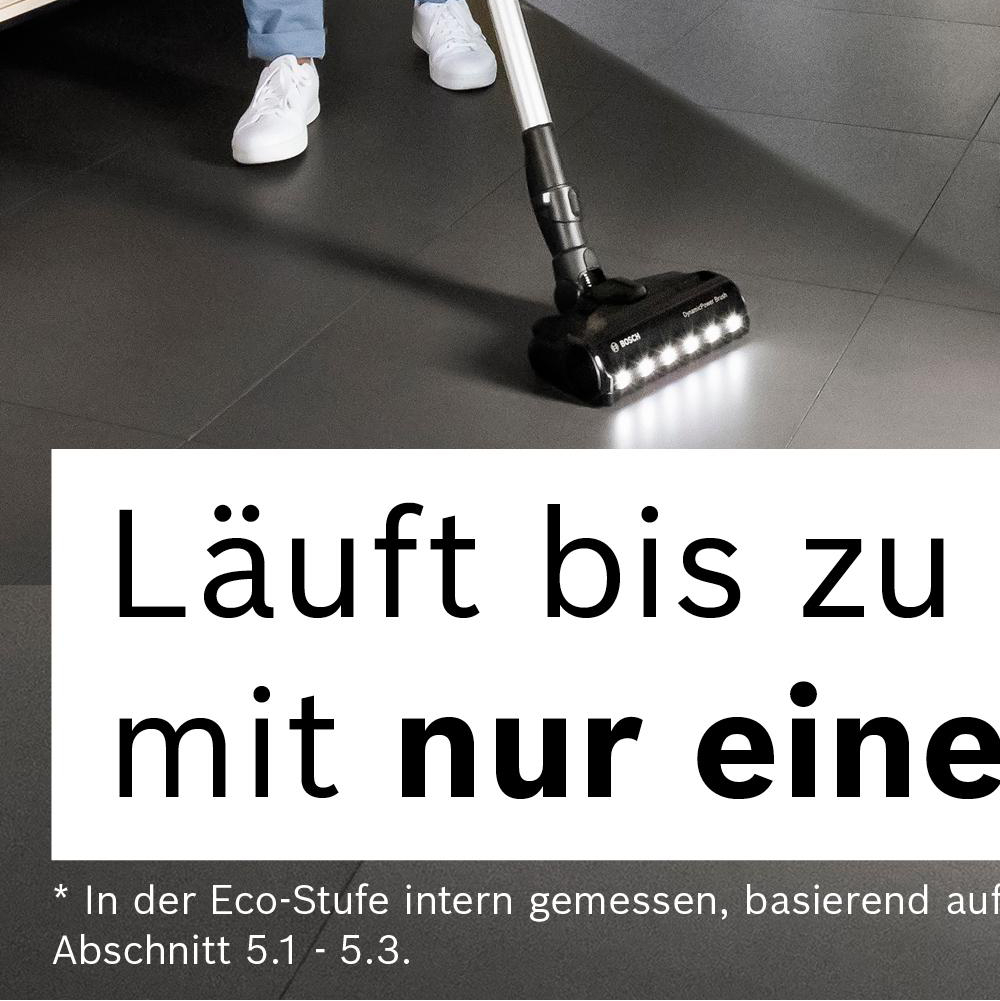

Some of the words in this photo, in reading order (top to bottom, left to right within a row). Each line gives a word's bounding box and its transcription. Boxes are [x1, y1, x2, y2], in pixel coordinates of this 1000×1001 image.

[682, 299, 714, 318] DynamicPower
[714, 292, 728, 302] Brush
[619, 332, 641, 348] BOSCH
